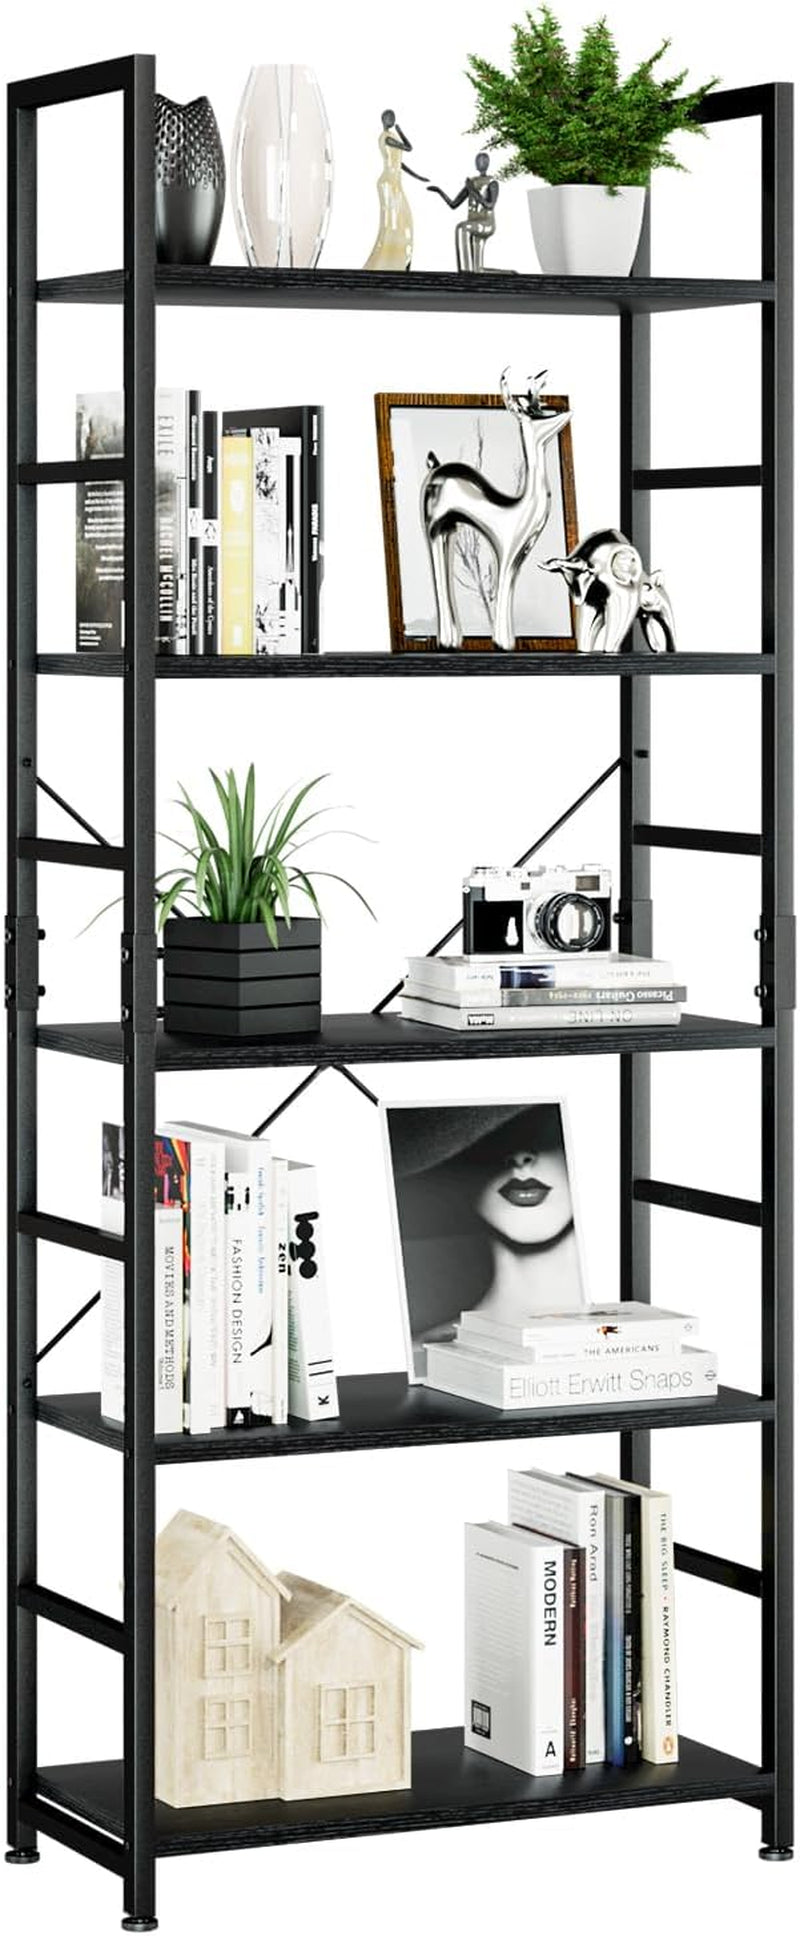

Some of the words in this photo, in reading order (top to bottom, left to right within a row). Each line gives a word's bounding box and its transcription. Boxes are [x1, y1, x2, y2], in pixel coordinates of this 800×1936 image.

[158, 415, 175, 456] EXILE
[158, 517, 175, 560] RACHEL
[637, 990, 674, 1002] Picasso
[278, 1242, 287, 1273] zen
[289, 1211, 320, 1279] logo
[164, 1246, 174, 1297] MOVIES
[231, 1239, 243, 1304] FASHION
[164, 1300, 174, 1327] AND
[231, 1309, 243, 1364] DESIGN
[584, 1347, 600, 1356] THE
[605, 1343, 660, 1355] AMERICANS
[164, 1329, 175, 1390] METHODS
[318, 1395, 330, 1406] K
[509, 1377, 561, 1400] Elliott
[568, 1372, 622, 1395] Erwitt
[629, 1369, 693, 1393] Snaps
[588, 1504, 599, 1540] Ron
[588, 1544, 599, 1582] Arad
[661, 1561, 669, 1591] SLEEP
[543, 1560, 557, 1647] MODERN
[662, 1606, 671, 1664] RAYMOND
[663, 1667, 673, 1727] CHANDLER
[544, 1740, 557, 1757] A
